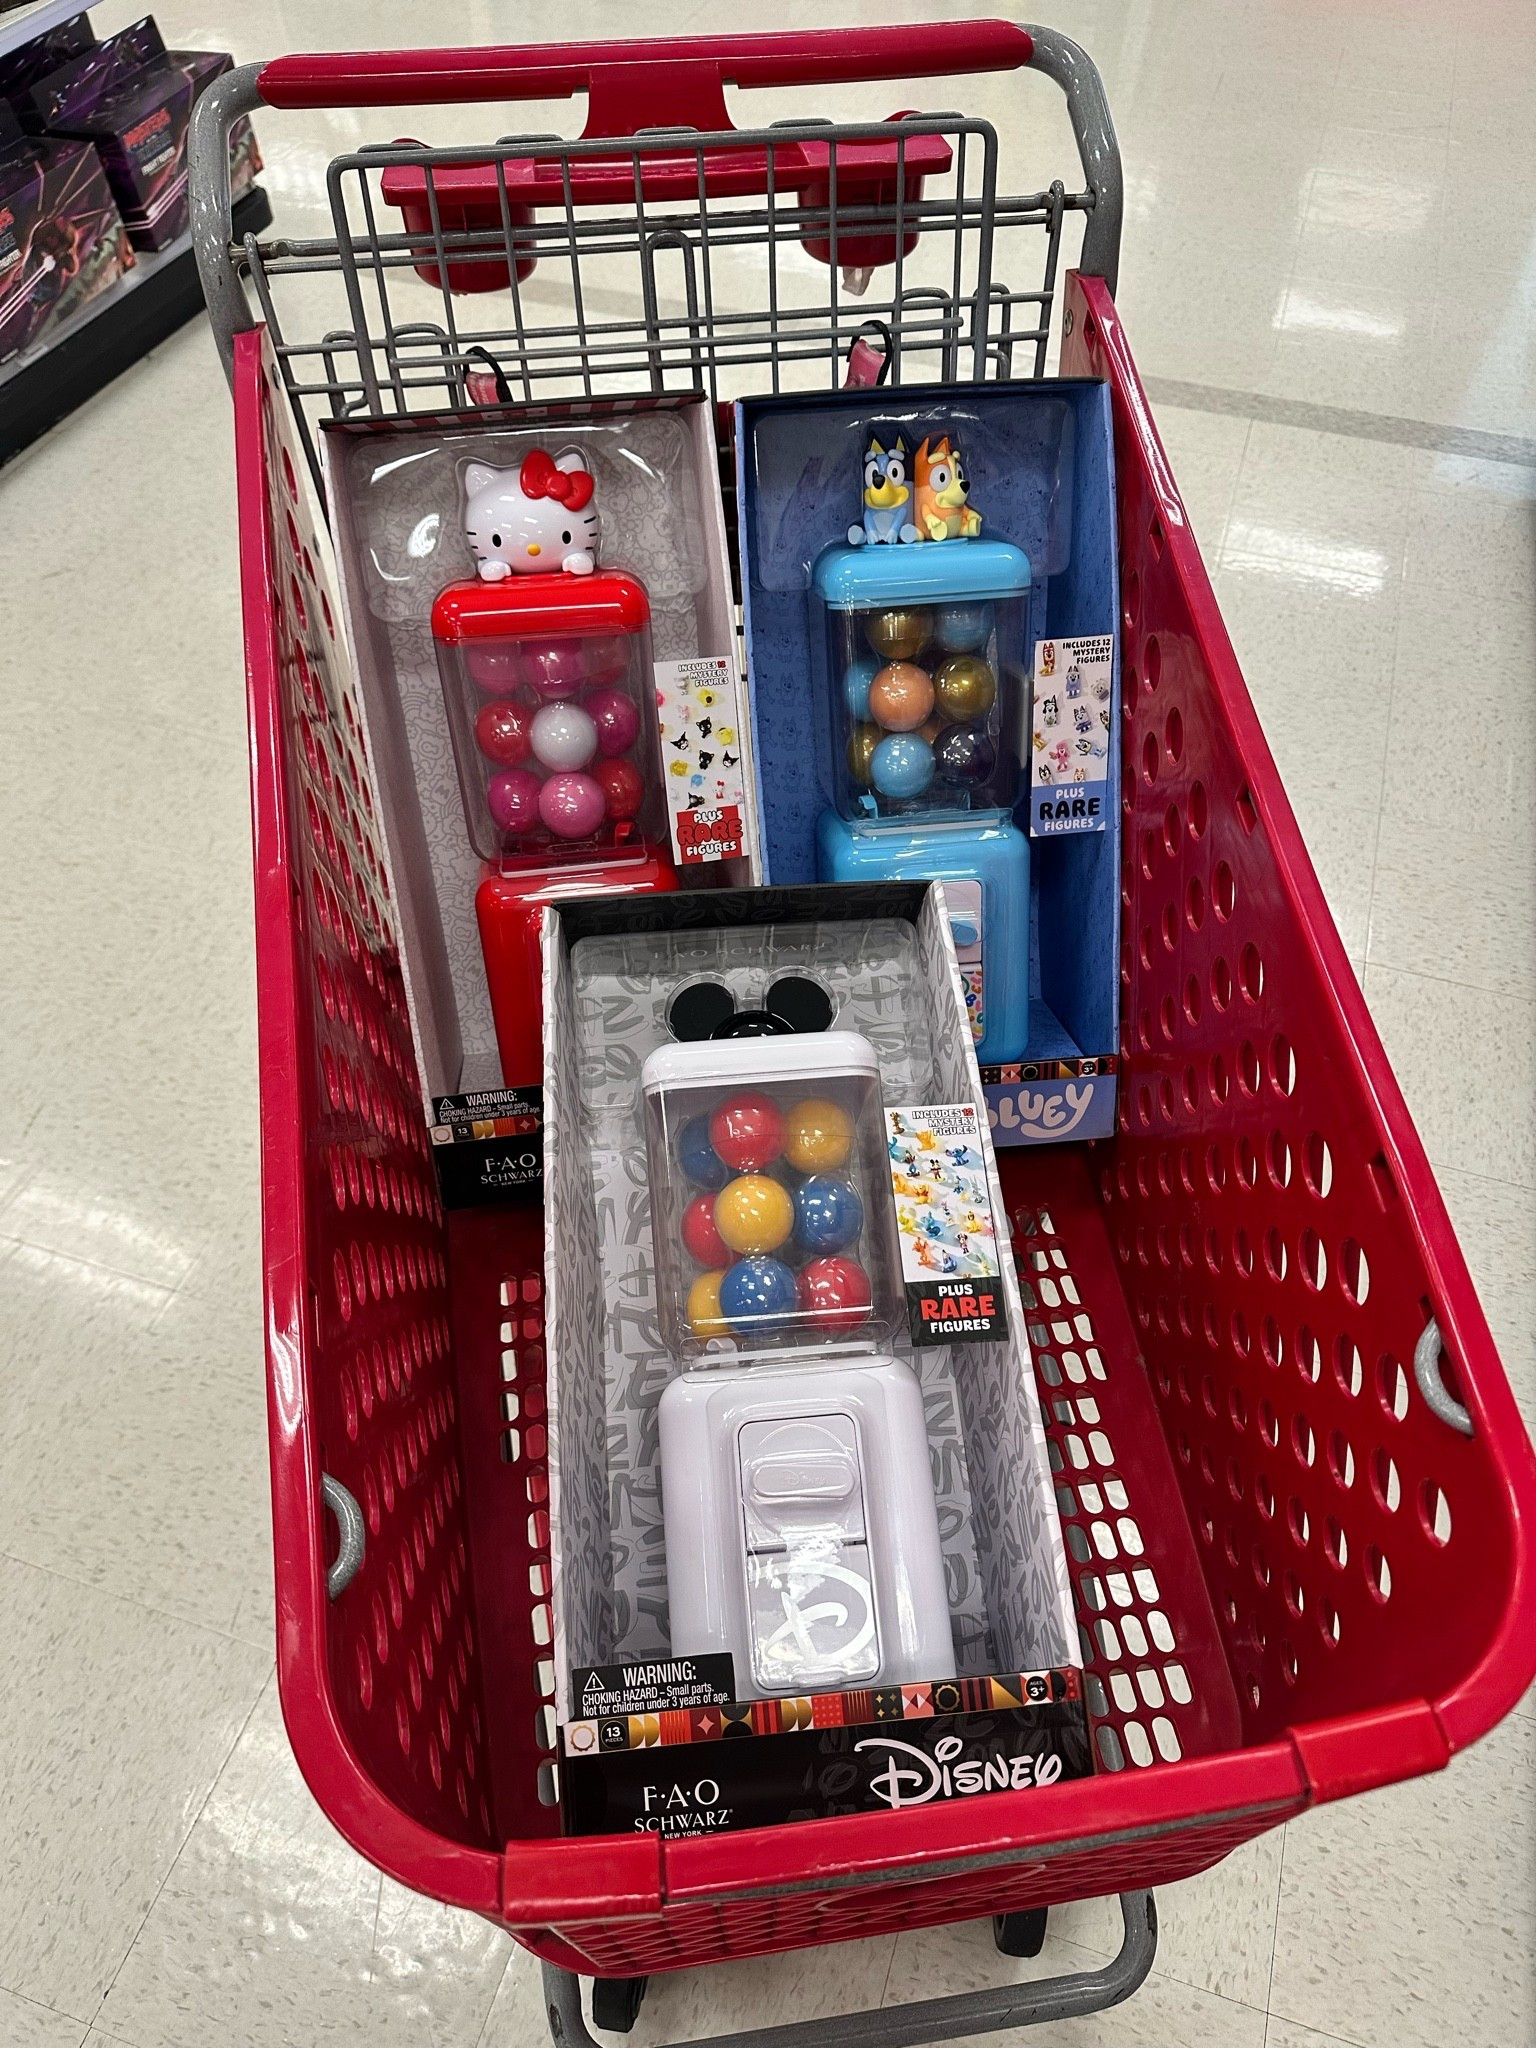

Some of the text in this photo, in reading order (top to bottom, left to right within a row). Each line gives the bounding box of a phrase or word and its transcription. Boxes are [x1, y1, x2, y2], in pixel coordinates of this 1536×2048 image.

[1062, 638, 1111, 650] INCLUDES 12
[1072, 647, 1110, 657] MYSTERY
[678, 661, 717, 672] INCLUDES
[1076, 655, 1110, 665] FIGURES
[690, 669, 728, 679] MYSTERY
[695, 677, 729, 687] FIGURES
[1056, 787, 1085, 800] PLUS
[1039, 797, 1101, 821] RARE
[693, 809, 723, 824] PLUS
[676, 818, 743, 845] RARE
[1044, 817, 1094, 832] FIGURES
[686, 841, 737, 857] FIGURES
[466, 1090, 518, 1107] WARNING:
[439, 1108, 467, 1119] CHOKING
[468, 1105, 492, 1115] HAZARD
[497, 1103, 514, 1111] Small
[440, 1116, 451, 1124] Not
[460, 1113, 483, 1122] children
[484, 1110, 500, 1118] under
[506, 1108, 521, 1116] years
[912, 1108, 974, 1119] INCLUDES 12
[928, 1116, 975, 1128] MYSTERY
[933, 1125, 976, 1137] FIGURES
[480, 1168, 543, 1185] SCHWARZ
[938, 1283, 973, 1297] PLUS
[920, 1295, 996, 1321] RARE
[930, 1318, 991, 1334] FIGURES
[622, 1660, 697, 1687] WARNING:
[582, 1690, 621, 1706] CHOKING
[623, 1686, 658, 1702] HAZARD
[666, 1684, 689, 1697] Small
[691, 1682, 714, 1696] parts.
[1030, 1685, 1045, 1697] 3+
[583, 1691, 730, 1717] Not for children under 3 years of age.
[606, 1726, 621, 1738] 13
[664, 1829, 702, 1840] NEW YORK
